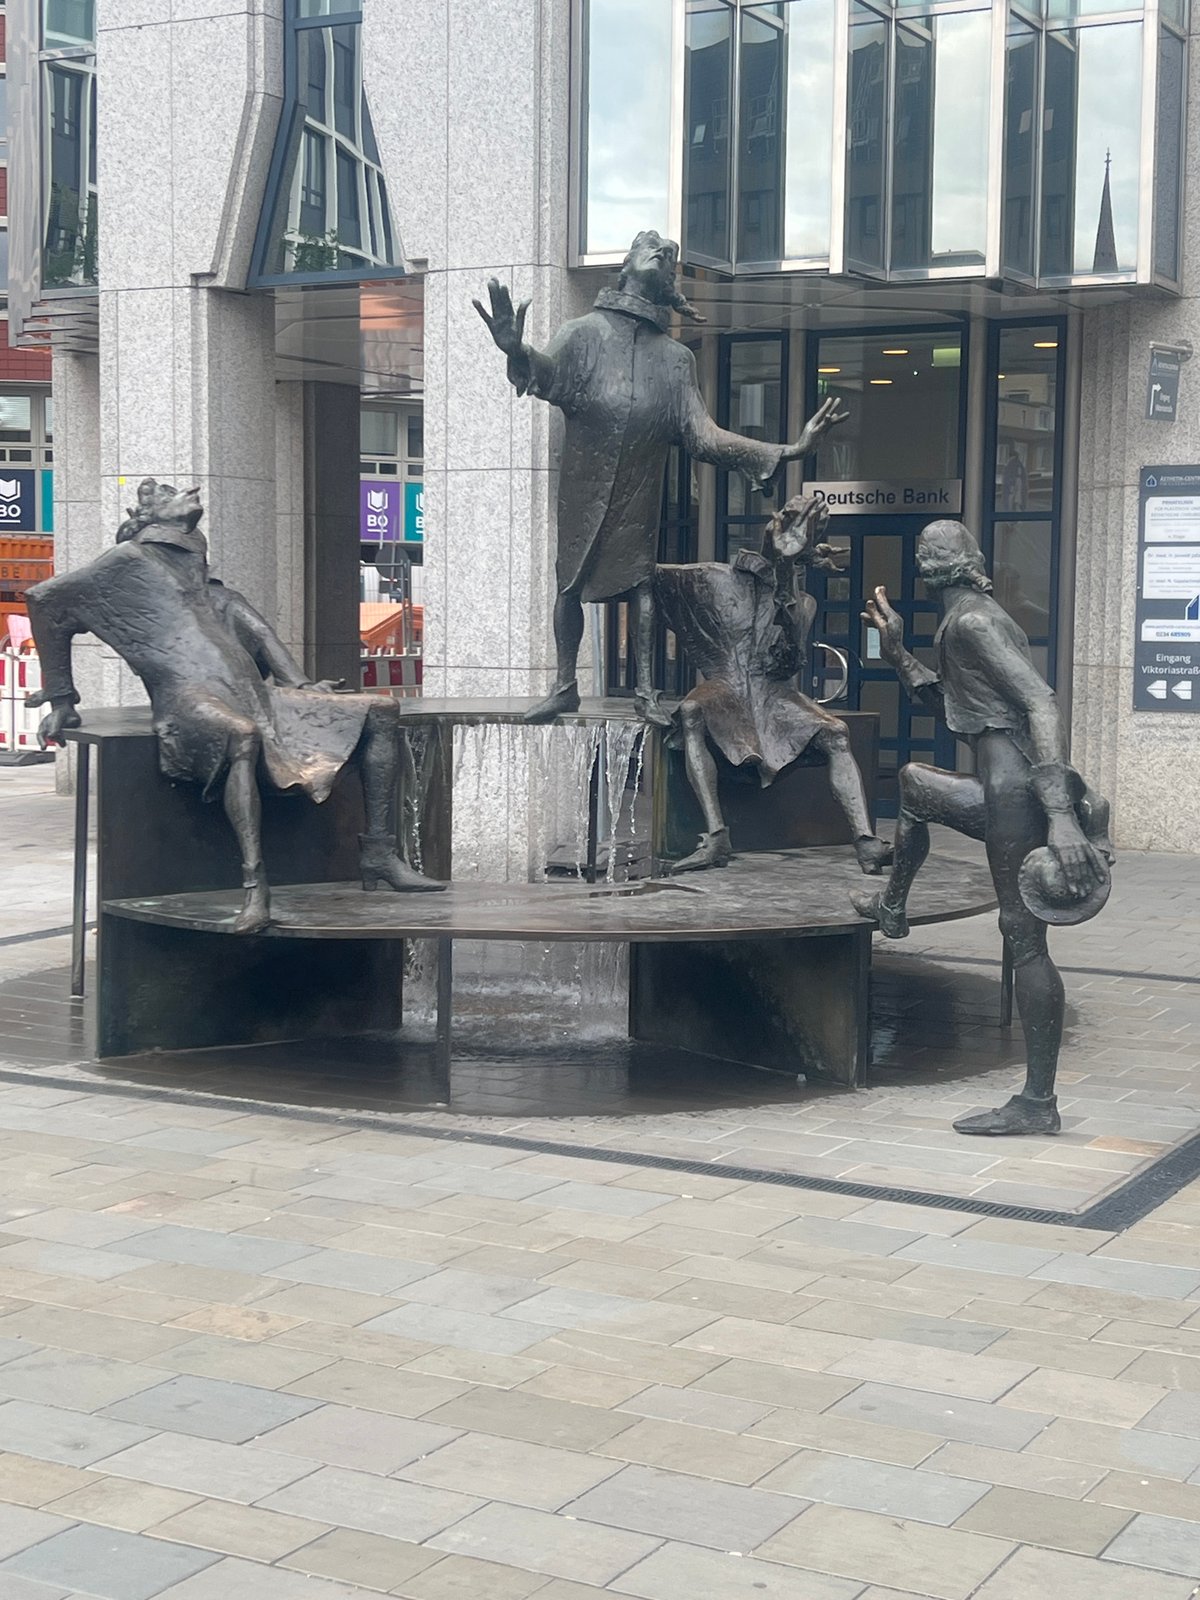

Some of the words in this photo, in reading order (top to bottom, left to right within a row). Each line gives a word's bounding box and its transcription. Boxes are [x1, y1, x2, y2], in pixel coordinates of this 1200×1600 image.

[813, 489, 896, 505] Deutsche
[903, 488, 949, 504] Bank
[367, 514, 388, 528] BO
[1156, 653, 1191, 664] Eingang
